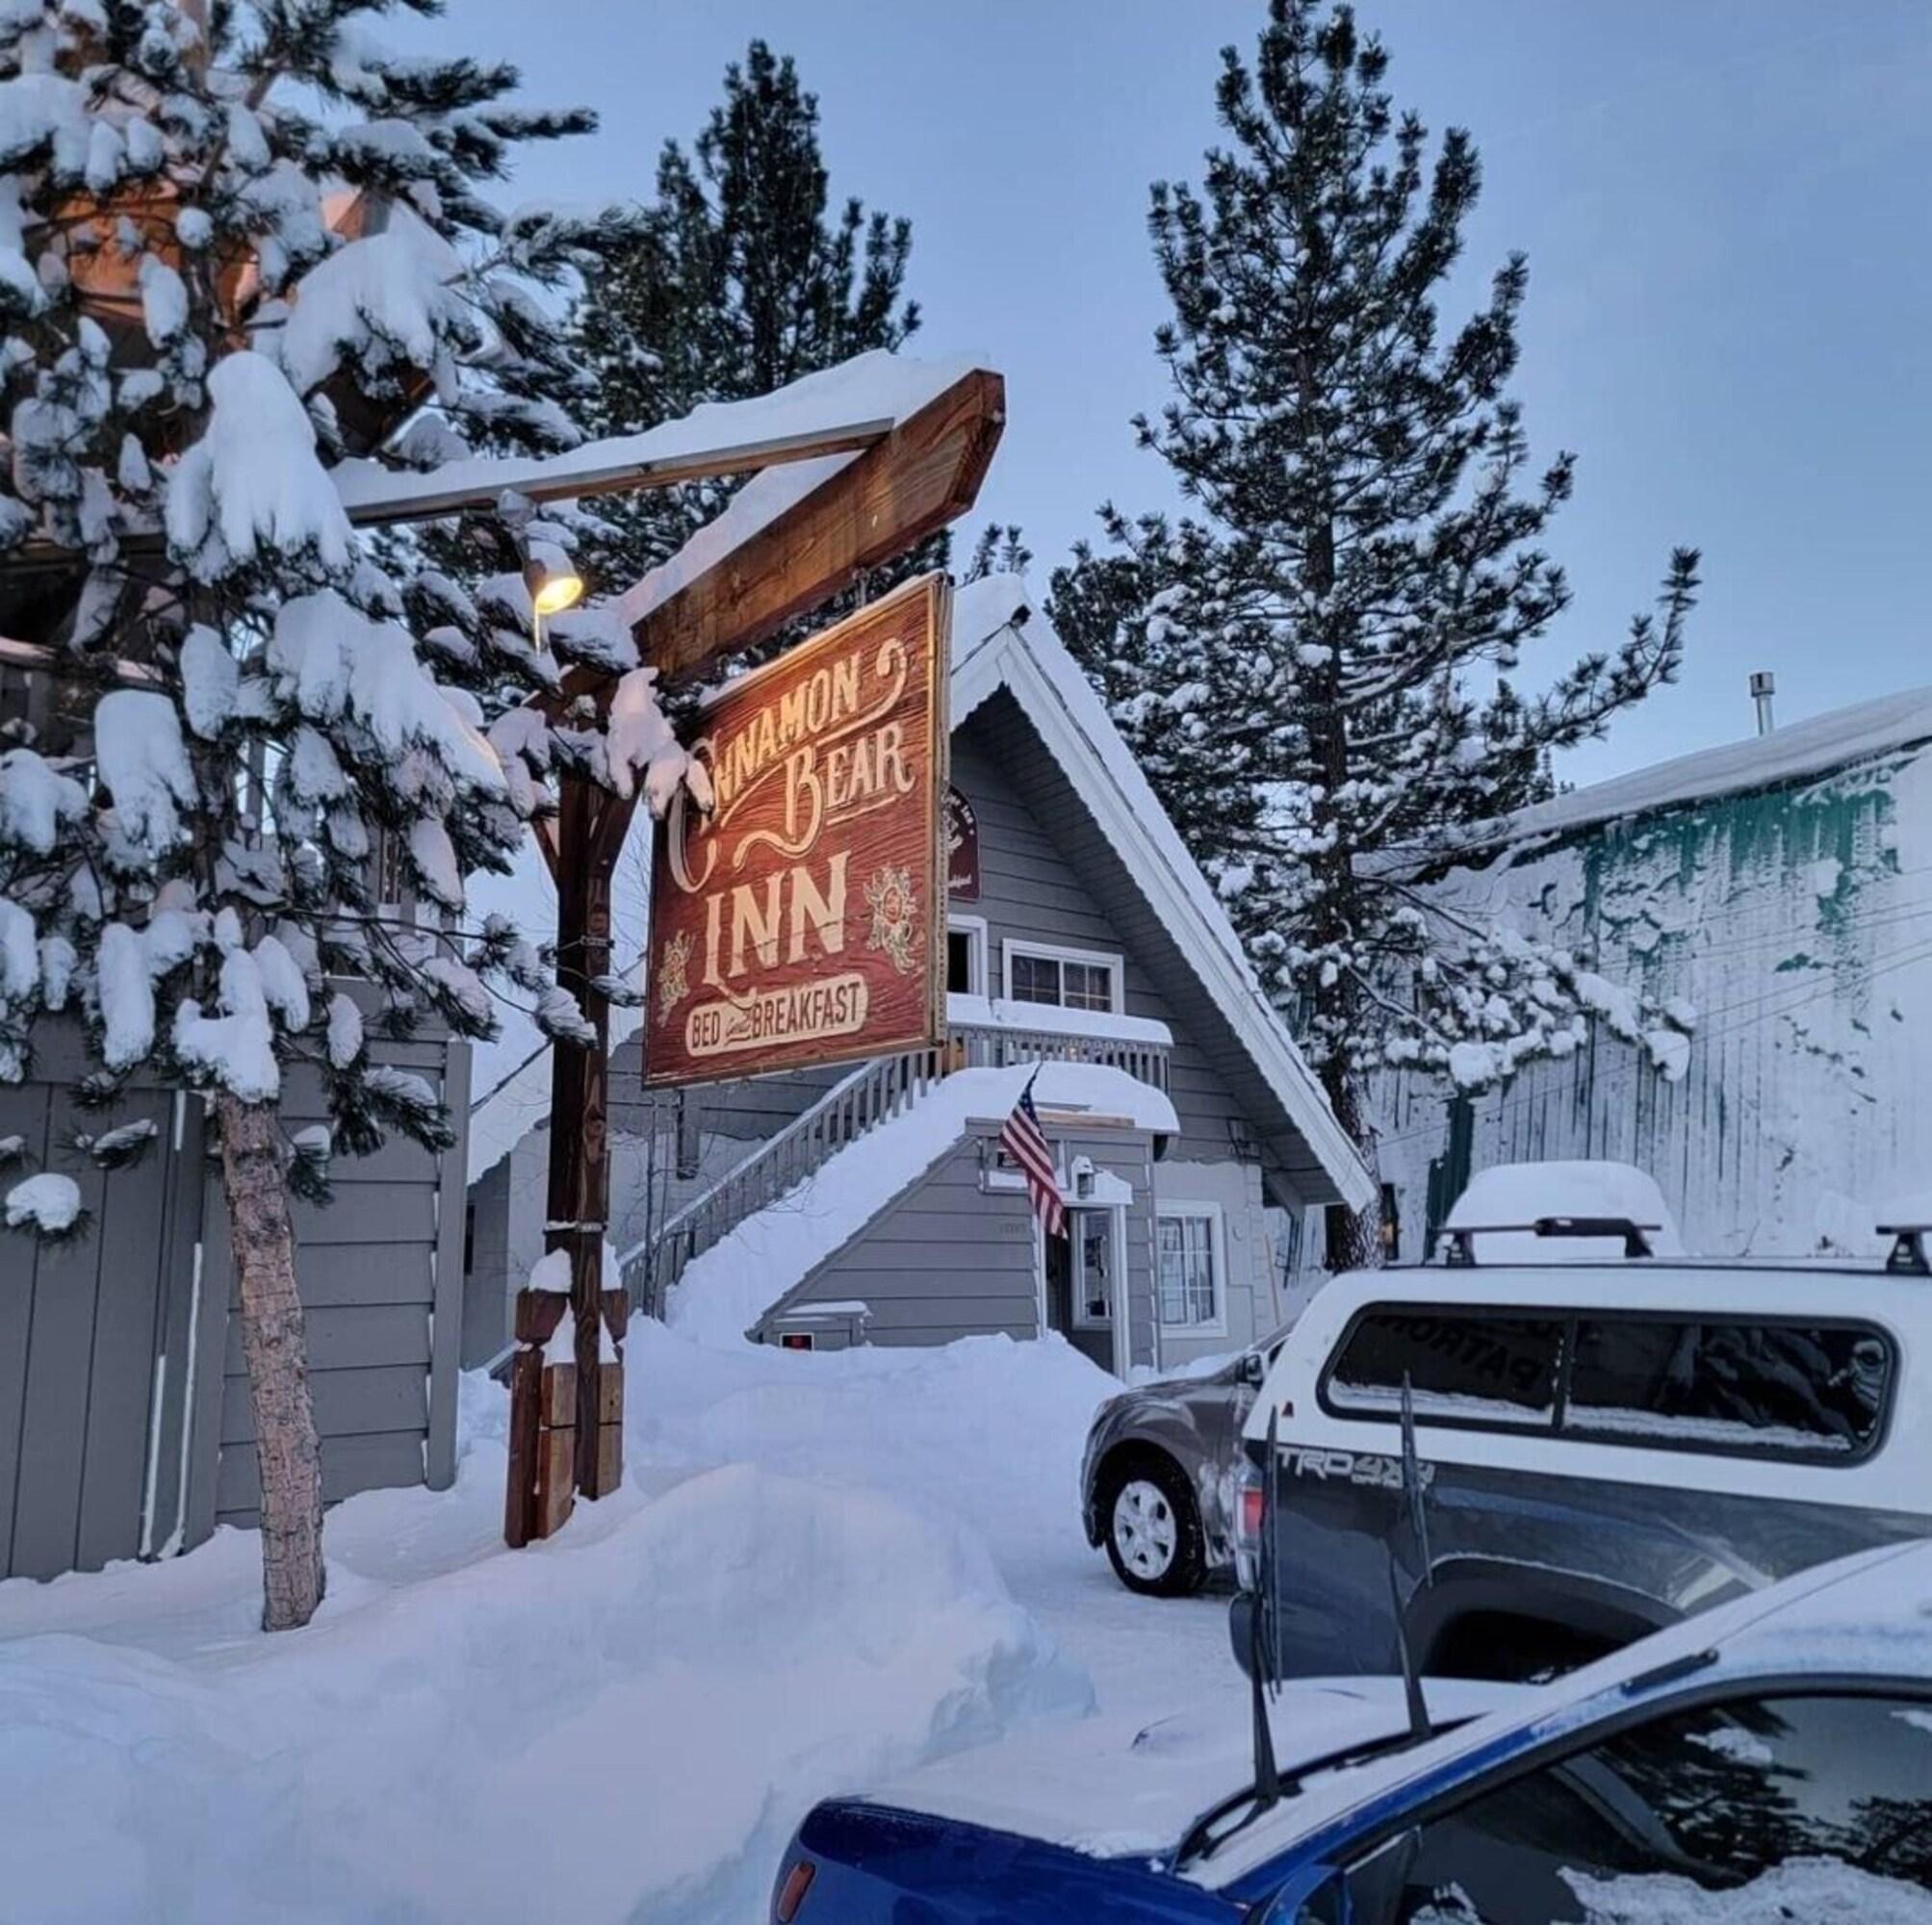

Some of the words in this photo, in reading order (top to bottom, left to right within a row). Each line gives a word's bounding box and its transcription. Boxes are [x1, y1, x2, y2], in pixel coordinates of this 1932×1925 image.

[668, 651, 862, 893] CNNAMON
[734, 721, 916, 859] BEAR
[702, 850, 852, 1010] INN
[692, 1011, 720, 1049] BED
[751, 980, 861, 1040] BREAKFAST
[1276, 1446, 1353, 1480] TRD
